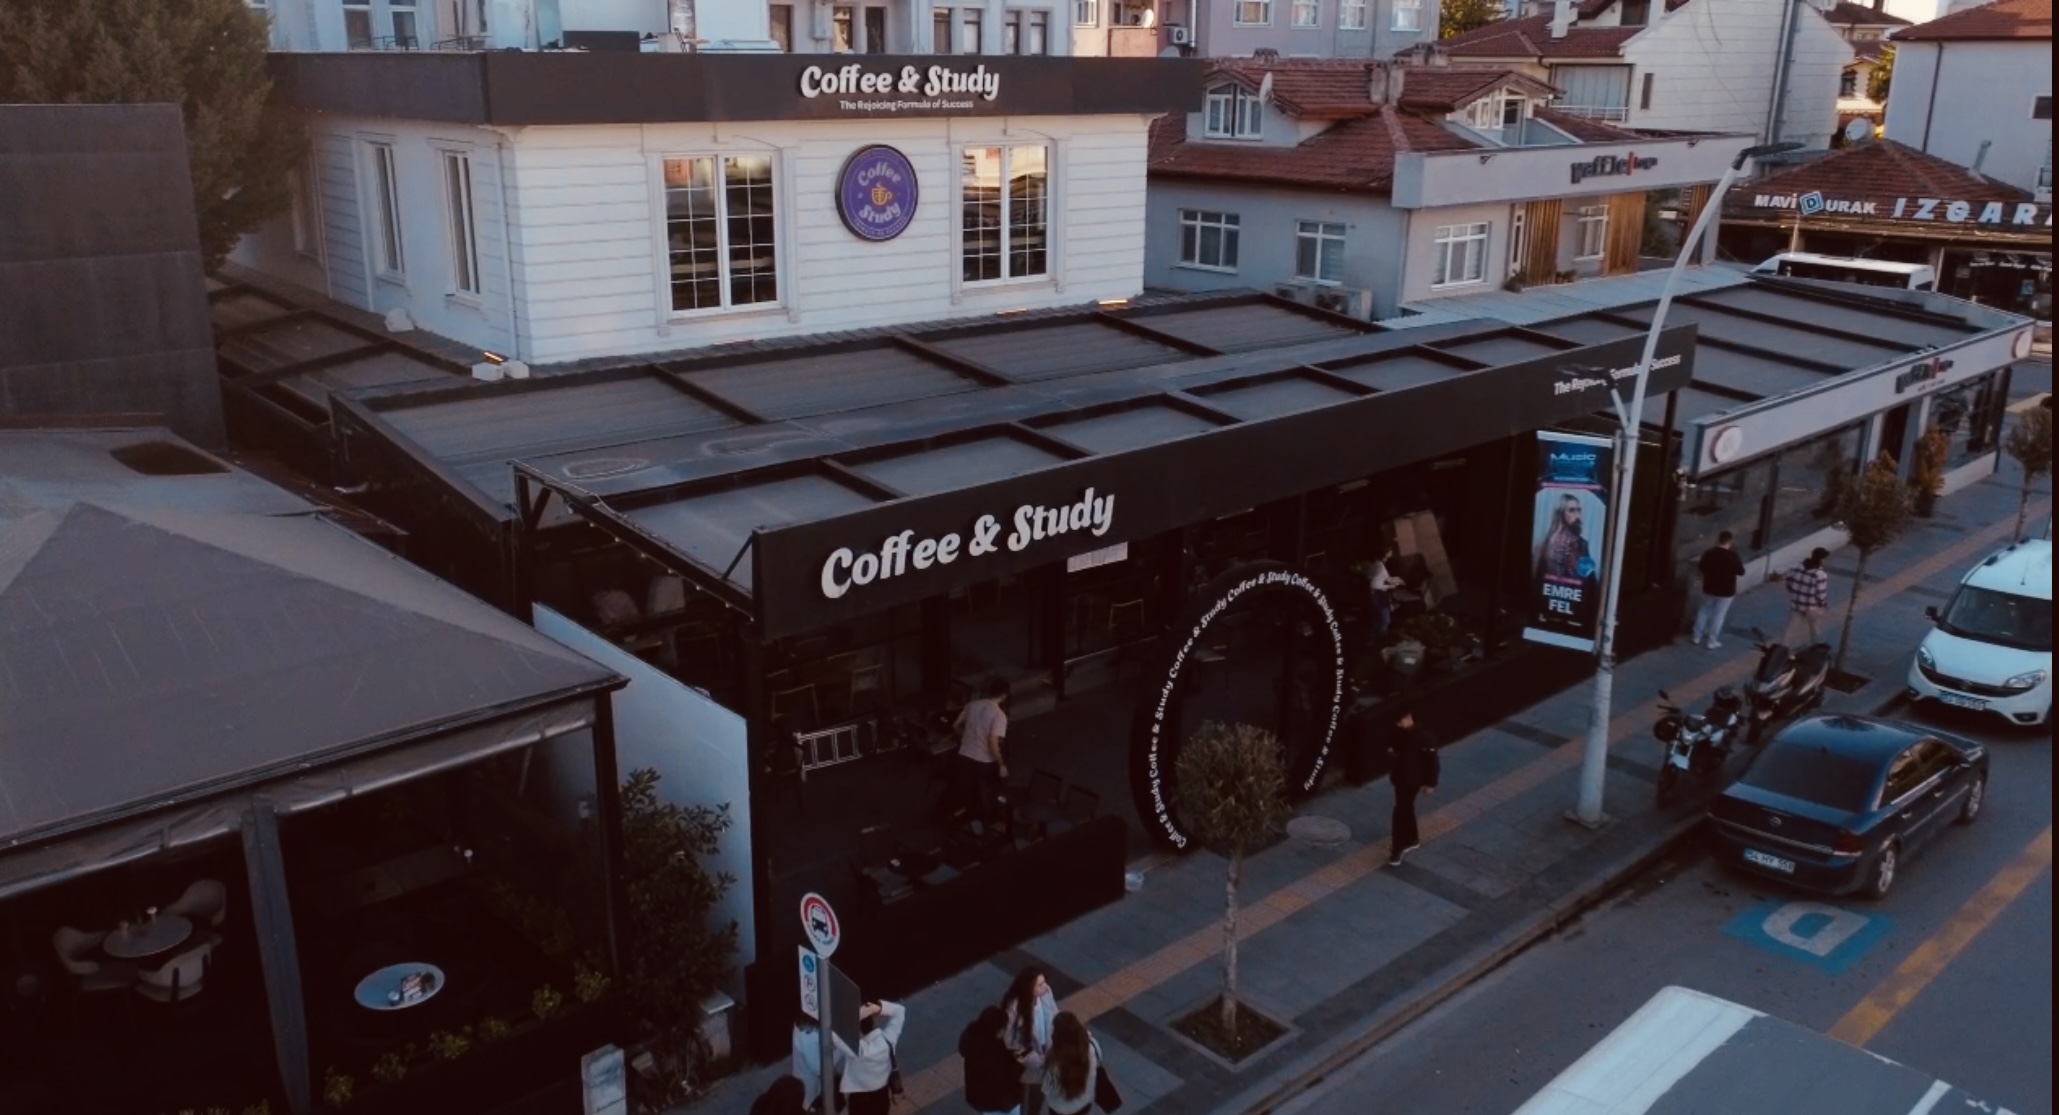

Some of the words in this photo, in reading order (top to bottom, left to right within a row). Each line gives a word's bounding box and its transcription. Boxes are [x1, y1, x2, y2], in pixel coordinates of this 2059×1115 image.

[801, 64, 893, 98] Coffee
[898, 65, 920, 93] &
[924, 64, 1000, 100] Study
[840, 100, 857, 110] The
[857, 100, 897, 112] Rejoicing
[897, 99, 931, 109] Formula
[932, 98, 942, 109] of
[942, 99, 974, 109] Success
[858, 161, 902, 186] Coffee
[859, 201, 901, 223] Study
[1554, 381, 1570, 395] The
[1650, 354, 1681, 371] Success
[821, 529, 960, 599] Coffee
[969, 514, 1001, 556] &
[1007, 487, 1115, 552] Study
[1227, 578, 1257, 602] Coffee
[1266, 569, 1291, 586] Study
[1291, 572, 1315, 594] Coffee
[1542, 582, 1583, 602] EMRE
[1200, 597, 1228, 629] Study
[1317, 594, 1335, 623] Study
[1548, 598, 1575, 616] FEL
[1329, 620, 1342, 656] Coffee
[1169, 637, 1194, 679] Coffee
[1154, 680, 1174, 720] Study
[1325, 704, 1341, 744] Coffee
[1148, 736, 1159, 778] Coffee
